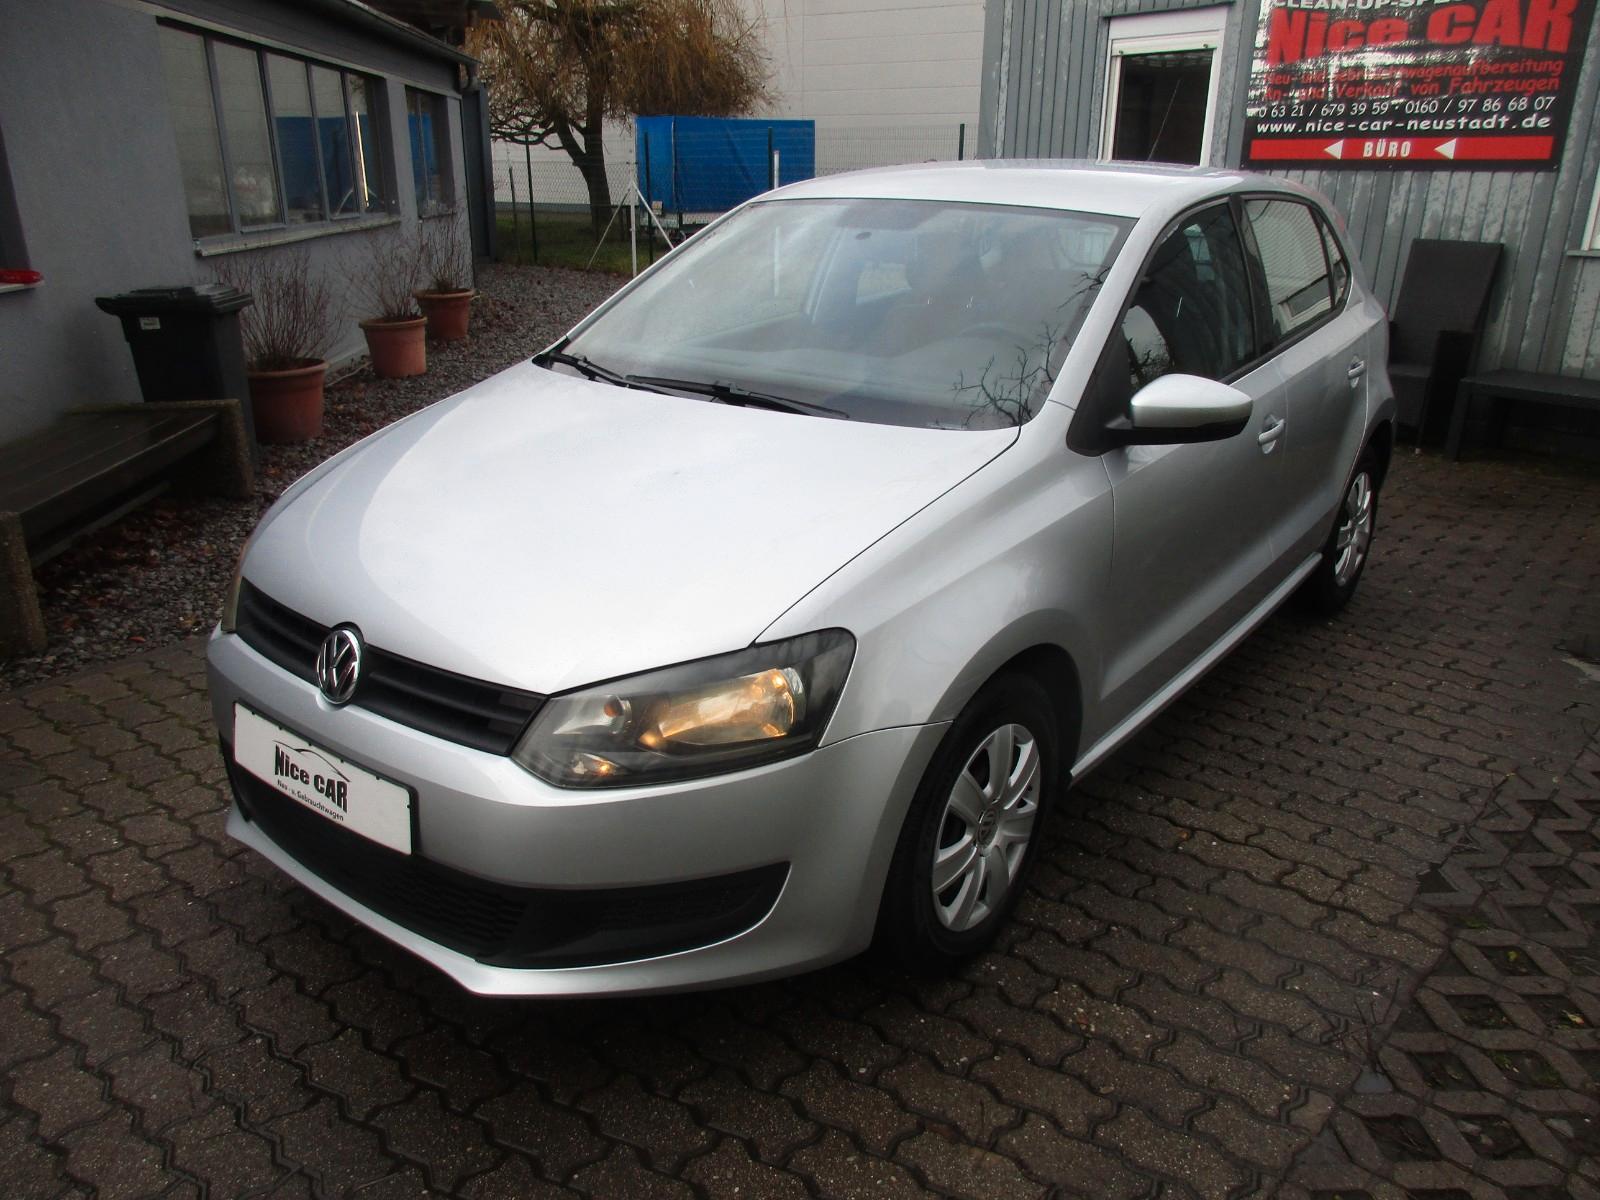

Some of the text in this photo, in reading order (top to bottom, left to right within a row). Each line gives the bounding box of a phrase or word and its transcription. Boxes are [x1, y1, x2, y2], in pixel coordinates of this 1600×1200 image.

[1267, 0, 1578, 67] Nice CAR
[1336, 80, 1401, 99] Verkauf
[1411, 83, 1440, 96] von
[1449, 76, 1560, 97] Fahrzeugen
[1271, 105, 1287, 118] 63
[1291, 104, 1304, 117] 21
[1320, 103, 1346, 117] 679
[1350, 102, 1367, 116] 39
[1371, 101, 1390, 115] 59
[1405, 100, 1439, 115] 0160
[1457, 99, 1478, 113] 97
[1482, 98, 1502, 112] 86
[1508, 97, 1528, 111] 68
[1534, 96, 1556, 112] 07
[1256, 113, 1552, 134] www.nice-car-neustadt.de
[1362, 139, 1412, 158] BÜRO
[275, 743, 348, 815] Nice CAR
[297, 789, 345, 822] Gebrauchtwagen
